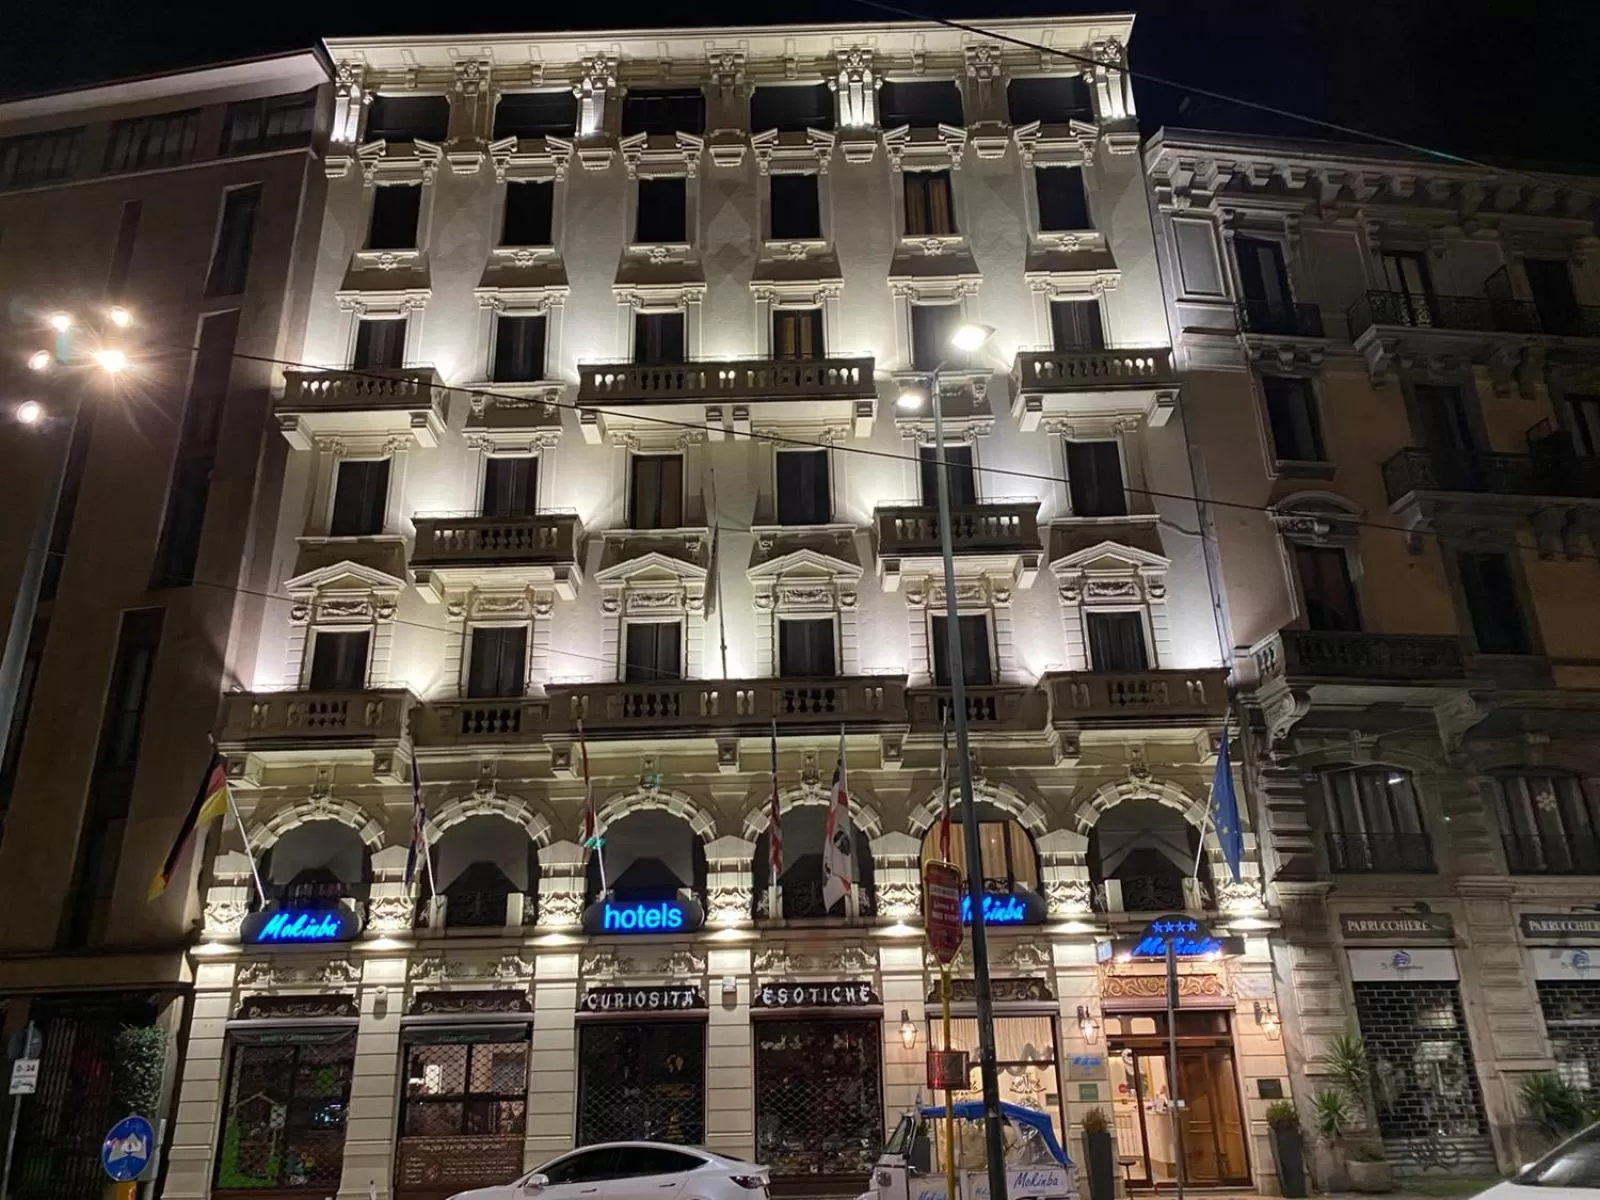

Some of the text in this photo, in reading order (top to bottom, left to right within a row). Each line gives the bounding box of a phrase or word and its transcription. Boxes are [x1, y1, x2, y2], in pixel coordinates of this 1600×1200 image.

[604, 902, 683, 929] hotels
[1347, 920, 1431, 931] PARRUCCHIERE
[257, 913, 337, 940] Mokinba
[762, 985, 870, 1005] ESOTICHE
[1014, 1172, 1058, 1188] Mokinba
